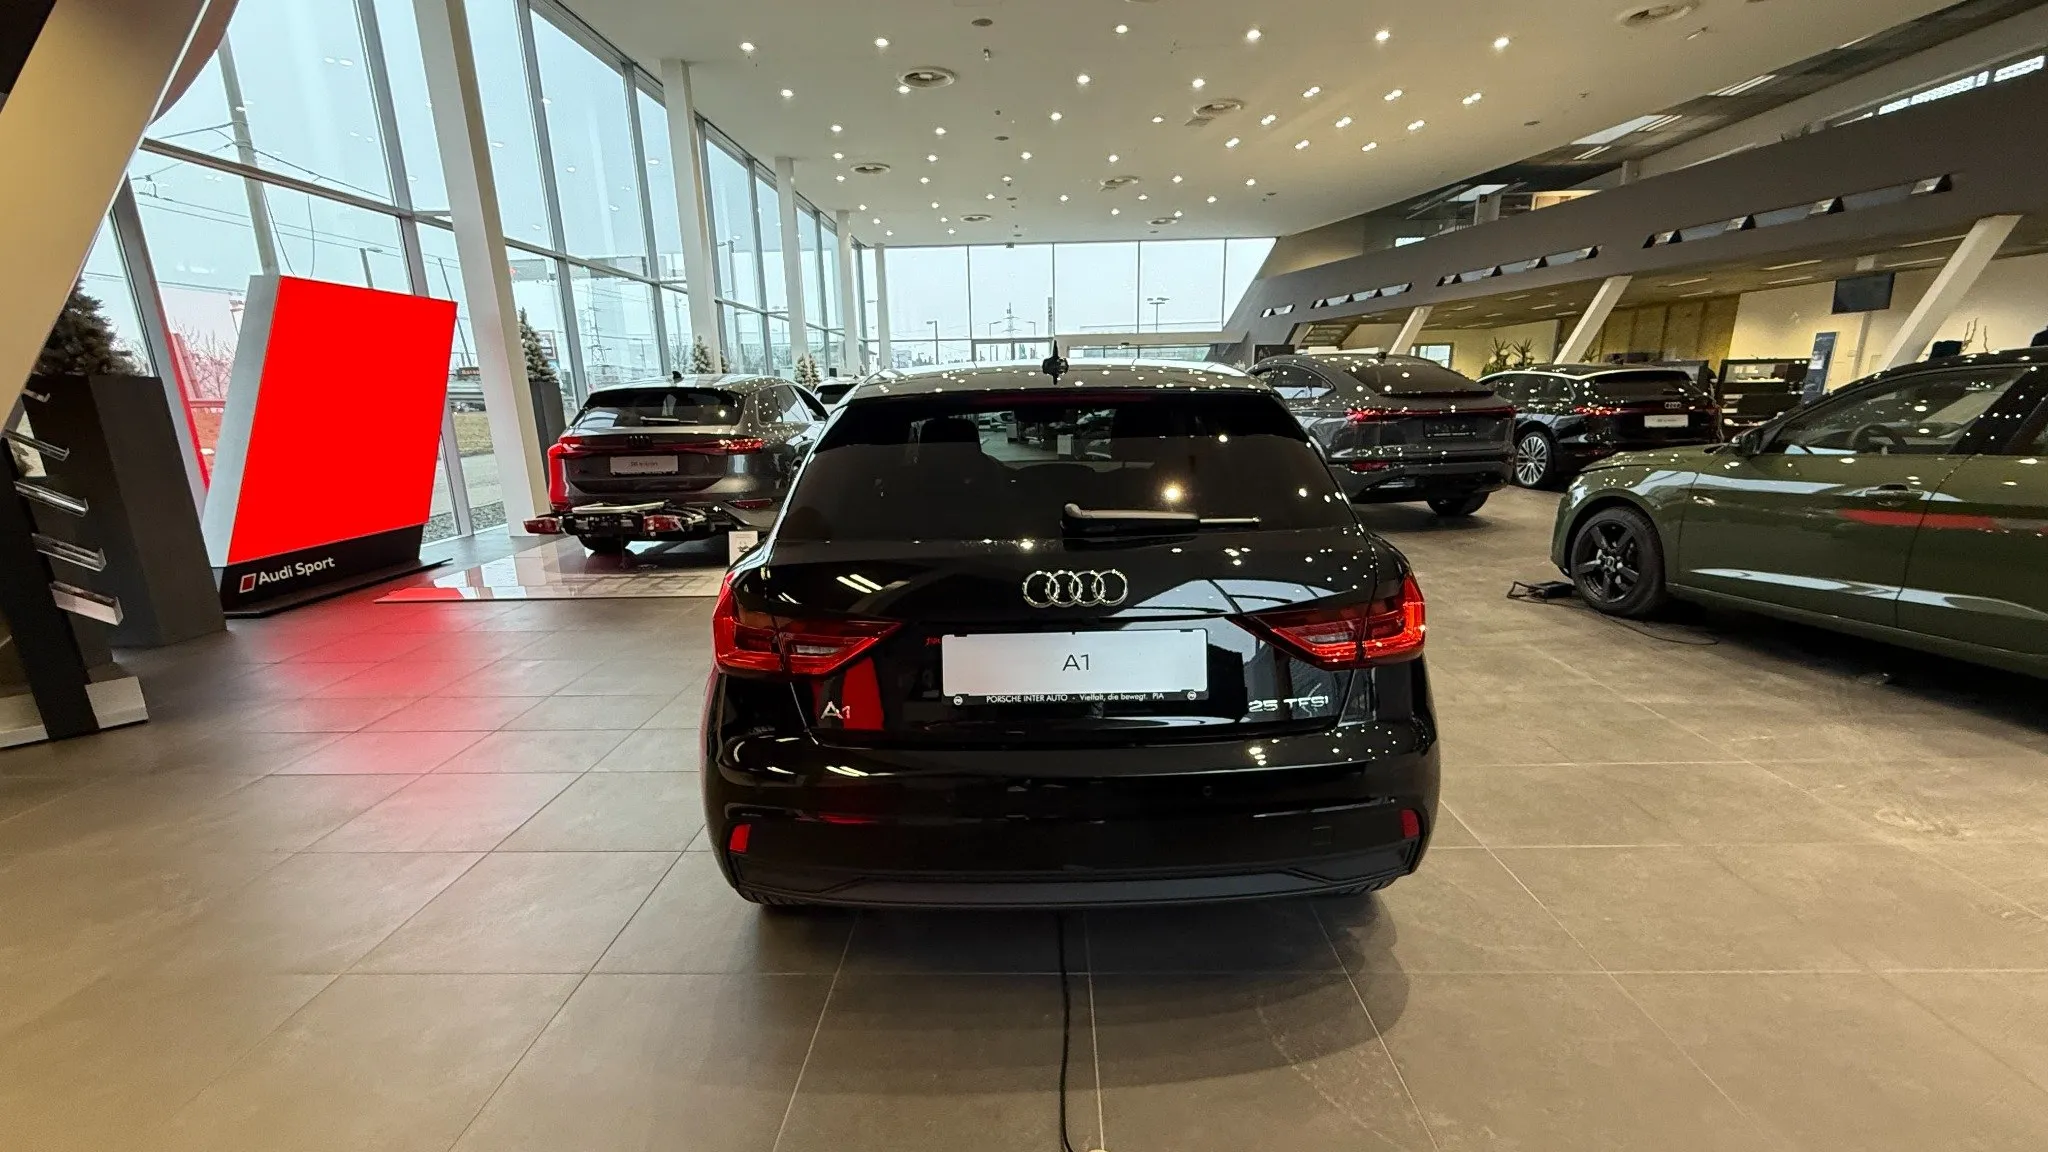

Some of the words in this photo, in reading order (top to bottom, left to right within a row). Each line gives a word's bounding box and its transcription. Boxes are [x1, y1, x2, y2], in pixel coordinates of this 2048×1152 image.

[258, 564, 294, 586] Audi
[295, 557, 336, 577] Sport
[1062, 653, 1090, 672] A1
[986, 695, 1022, 704] PORSCHE
[1023, 694, 1045, 703] INTER
[1046, 694, 1068, 702] AUTO
[1107, 693, 1119, 701] die
[1248, 699, 1279, 713] 25
[1283, 695, 1329, 709] TFSI
[820, 700, 851, 720] A1
